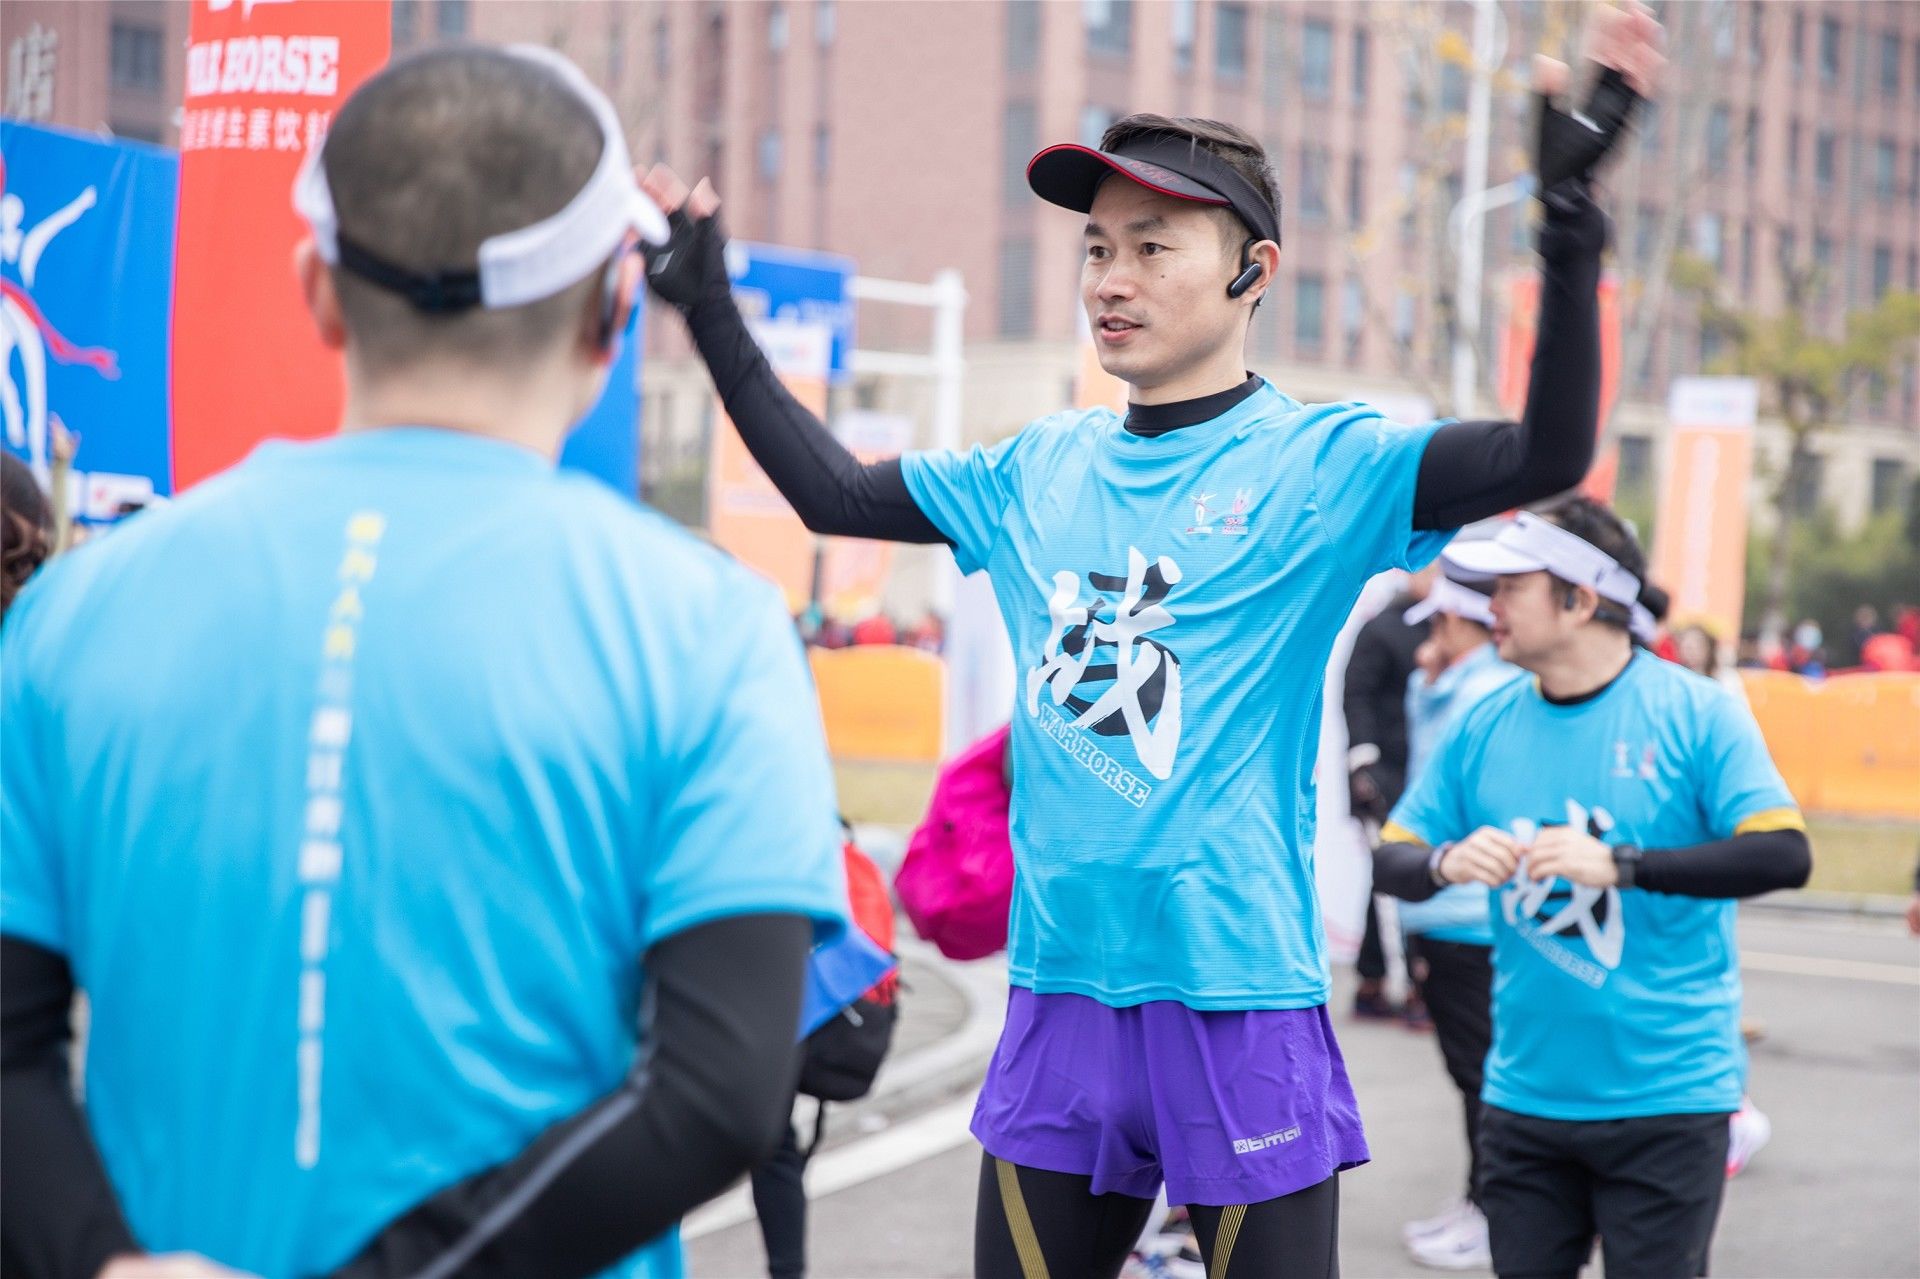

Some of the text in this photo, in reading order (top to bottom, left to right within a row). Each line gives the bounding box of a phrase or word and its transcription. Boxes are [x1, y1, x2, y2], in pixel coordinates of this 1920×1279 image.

[221, 35, 338, 95] HORSE
[1039, 702, 1152, 808] WAR HORSE
